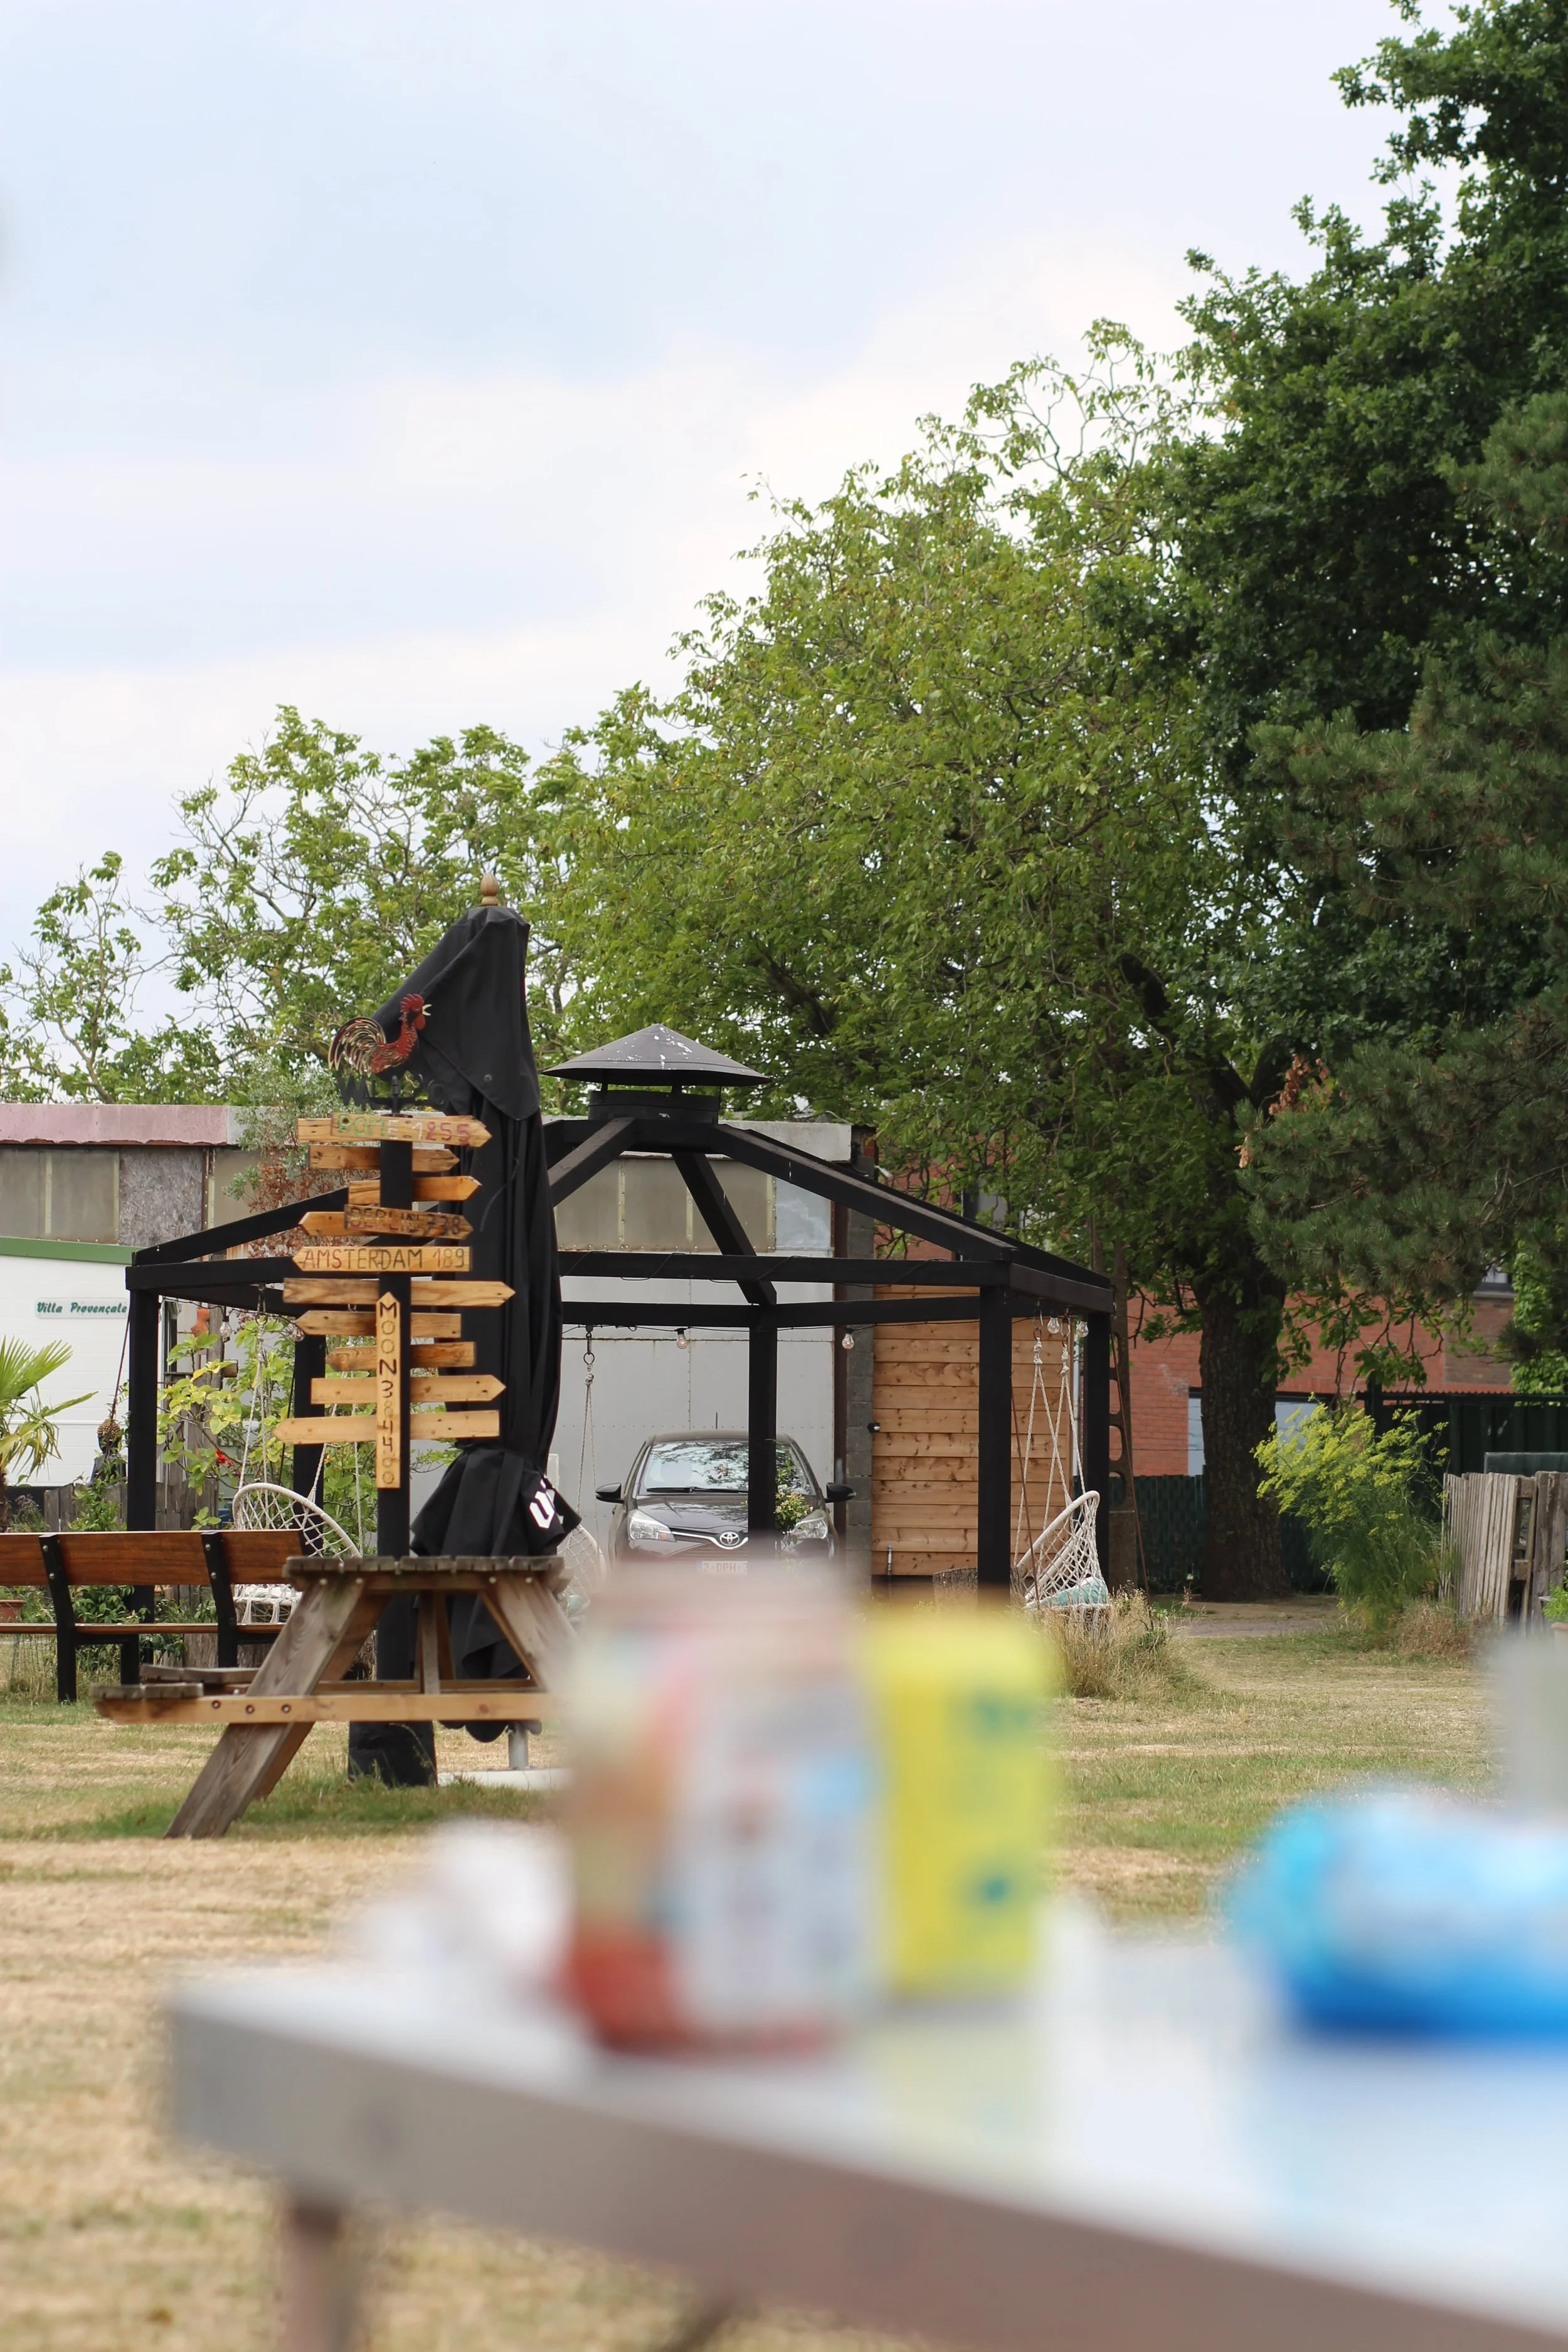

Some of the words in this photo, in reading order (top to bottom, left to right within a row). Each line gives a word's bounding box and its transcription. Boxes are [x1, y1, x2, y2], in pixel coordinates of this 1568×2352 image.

[337, 1114, 400, 1140] ROME
[349, 1207, 420, 1233] BERLIN
[302, 1249, 423, 1270] AMSTERDAM
[433, 1248, 465, 1268] 189
[36, 1302, 63, 1313] Villa
[70, 1301, 127, 1315] Provençale
[379, 1301, 397, 1376] MOON
